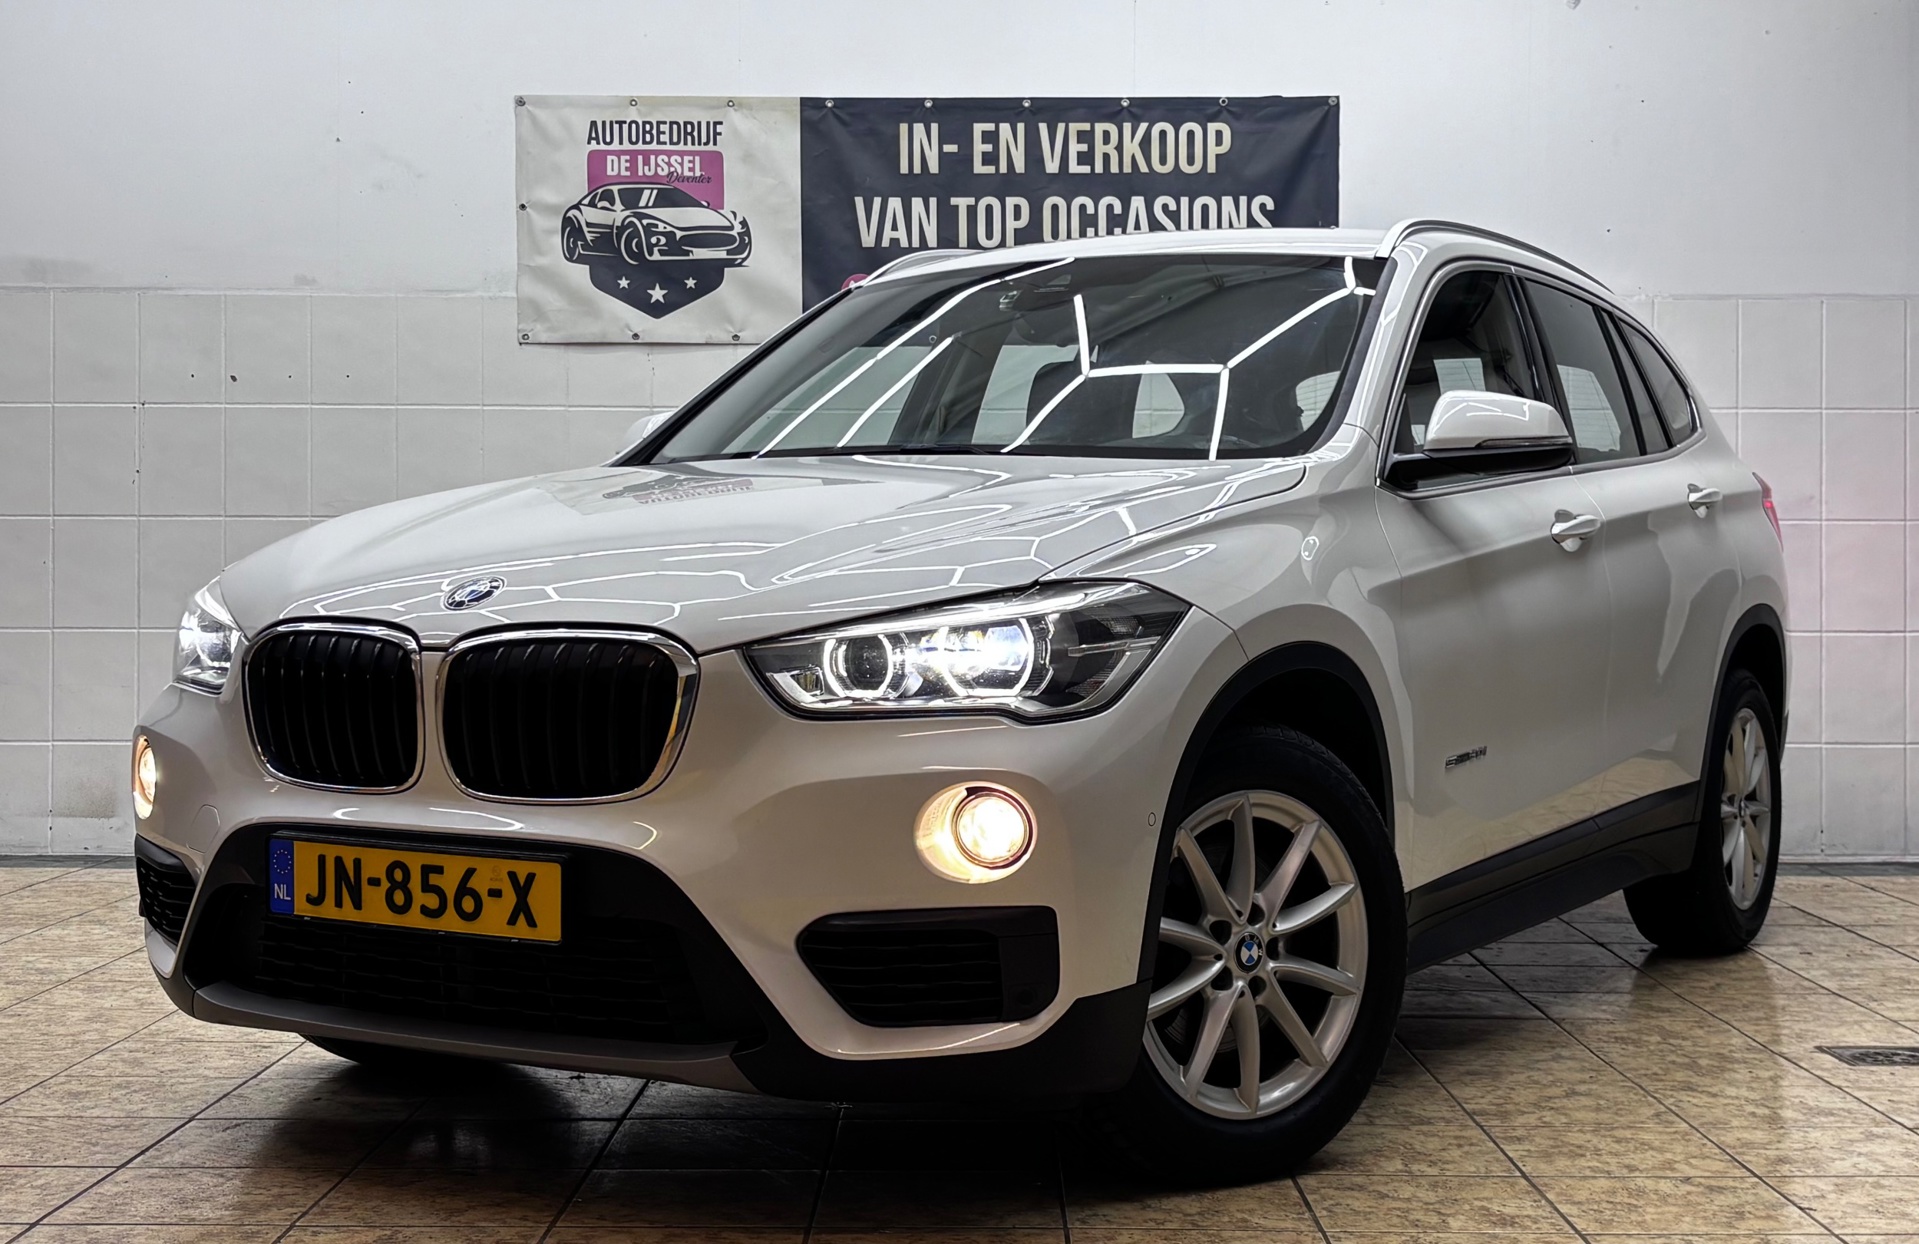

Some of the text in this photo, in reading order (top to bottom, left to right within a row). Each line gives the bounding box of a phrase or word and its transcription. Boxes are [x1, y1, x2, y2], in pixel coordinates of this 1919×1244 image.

[586, 119, 723, 147] AUTOBEDRIJF
[899, 121, 1233, 175] IN- EN VERKOOP
[606, 154, 705, 177] DE IJSSEL
[666, 170, 713, 184] Deventer
[853, 195, 1275, 248] VAN TOP OCCASIONS
[273, 883, 292, 901] NL
[305, 853, 538, 929] JN-856-X
